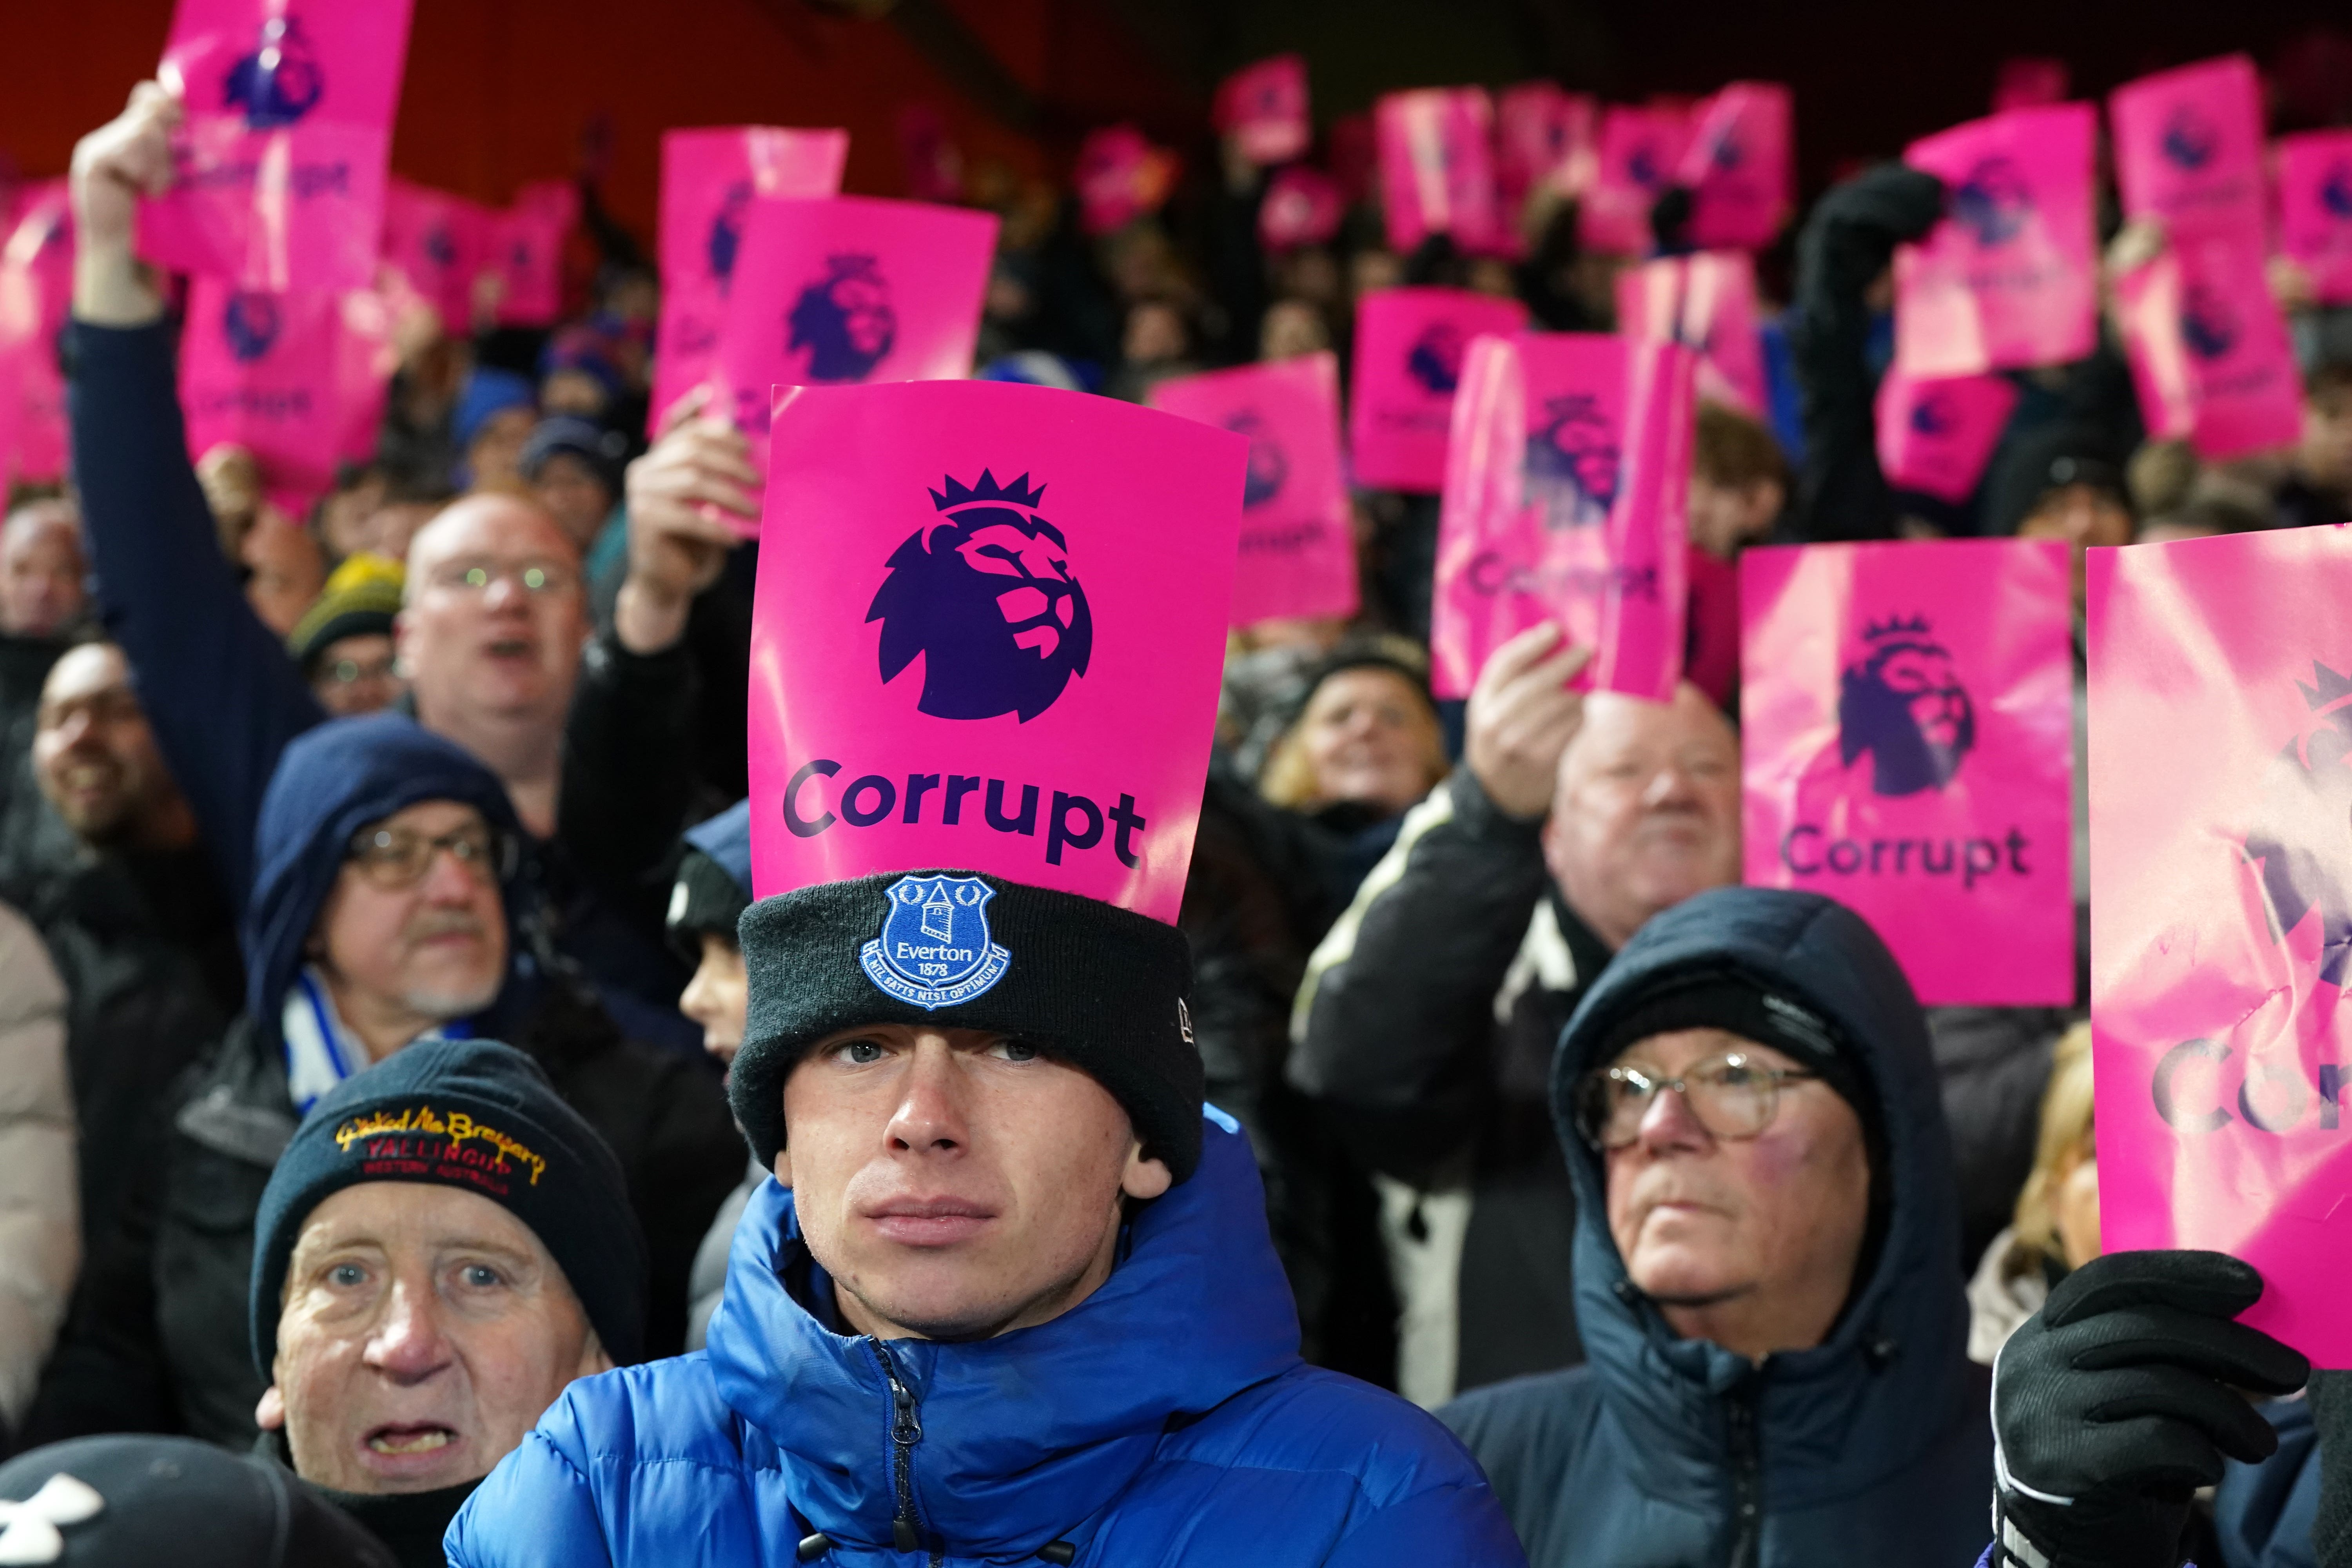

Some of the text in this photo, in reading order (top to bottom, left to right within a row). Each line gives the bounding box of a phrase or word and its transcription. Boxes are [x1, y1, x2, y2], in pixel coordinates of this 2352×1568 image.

[783, 759, 1145, 870] Corrupt
[1781, 824, 2031, 891] Corrupt
[897, 942, 973, 962] Everton
[918, 962, 948, 976] 1878
[869, 959, 999, 1001] NIL SATIS NISI OPTIMUM
[367, 1138, 512, 1175] YALLINGUP
